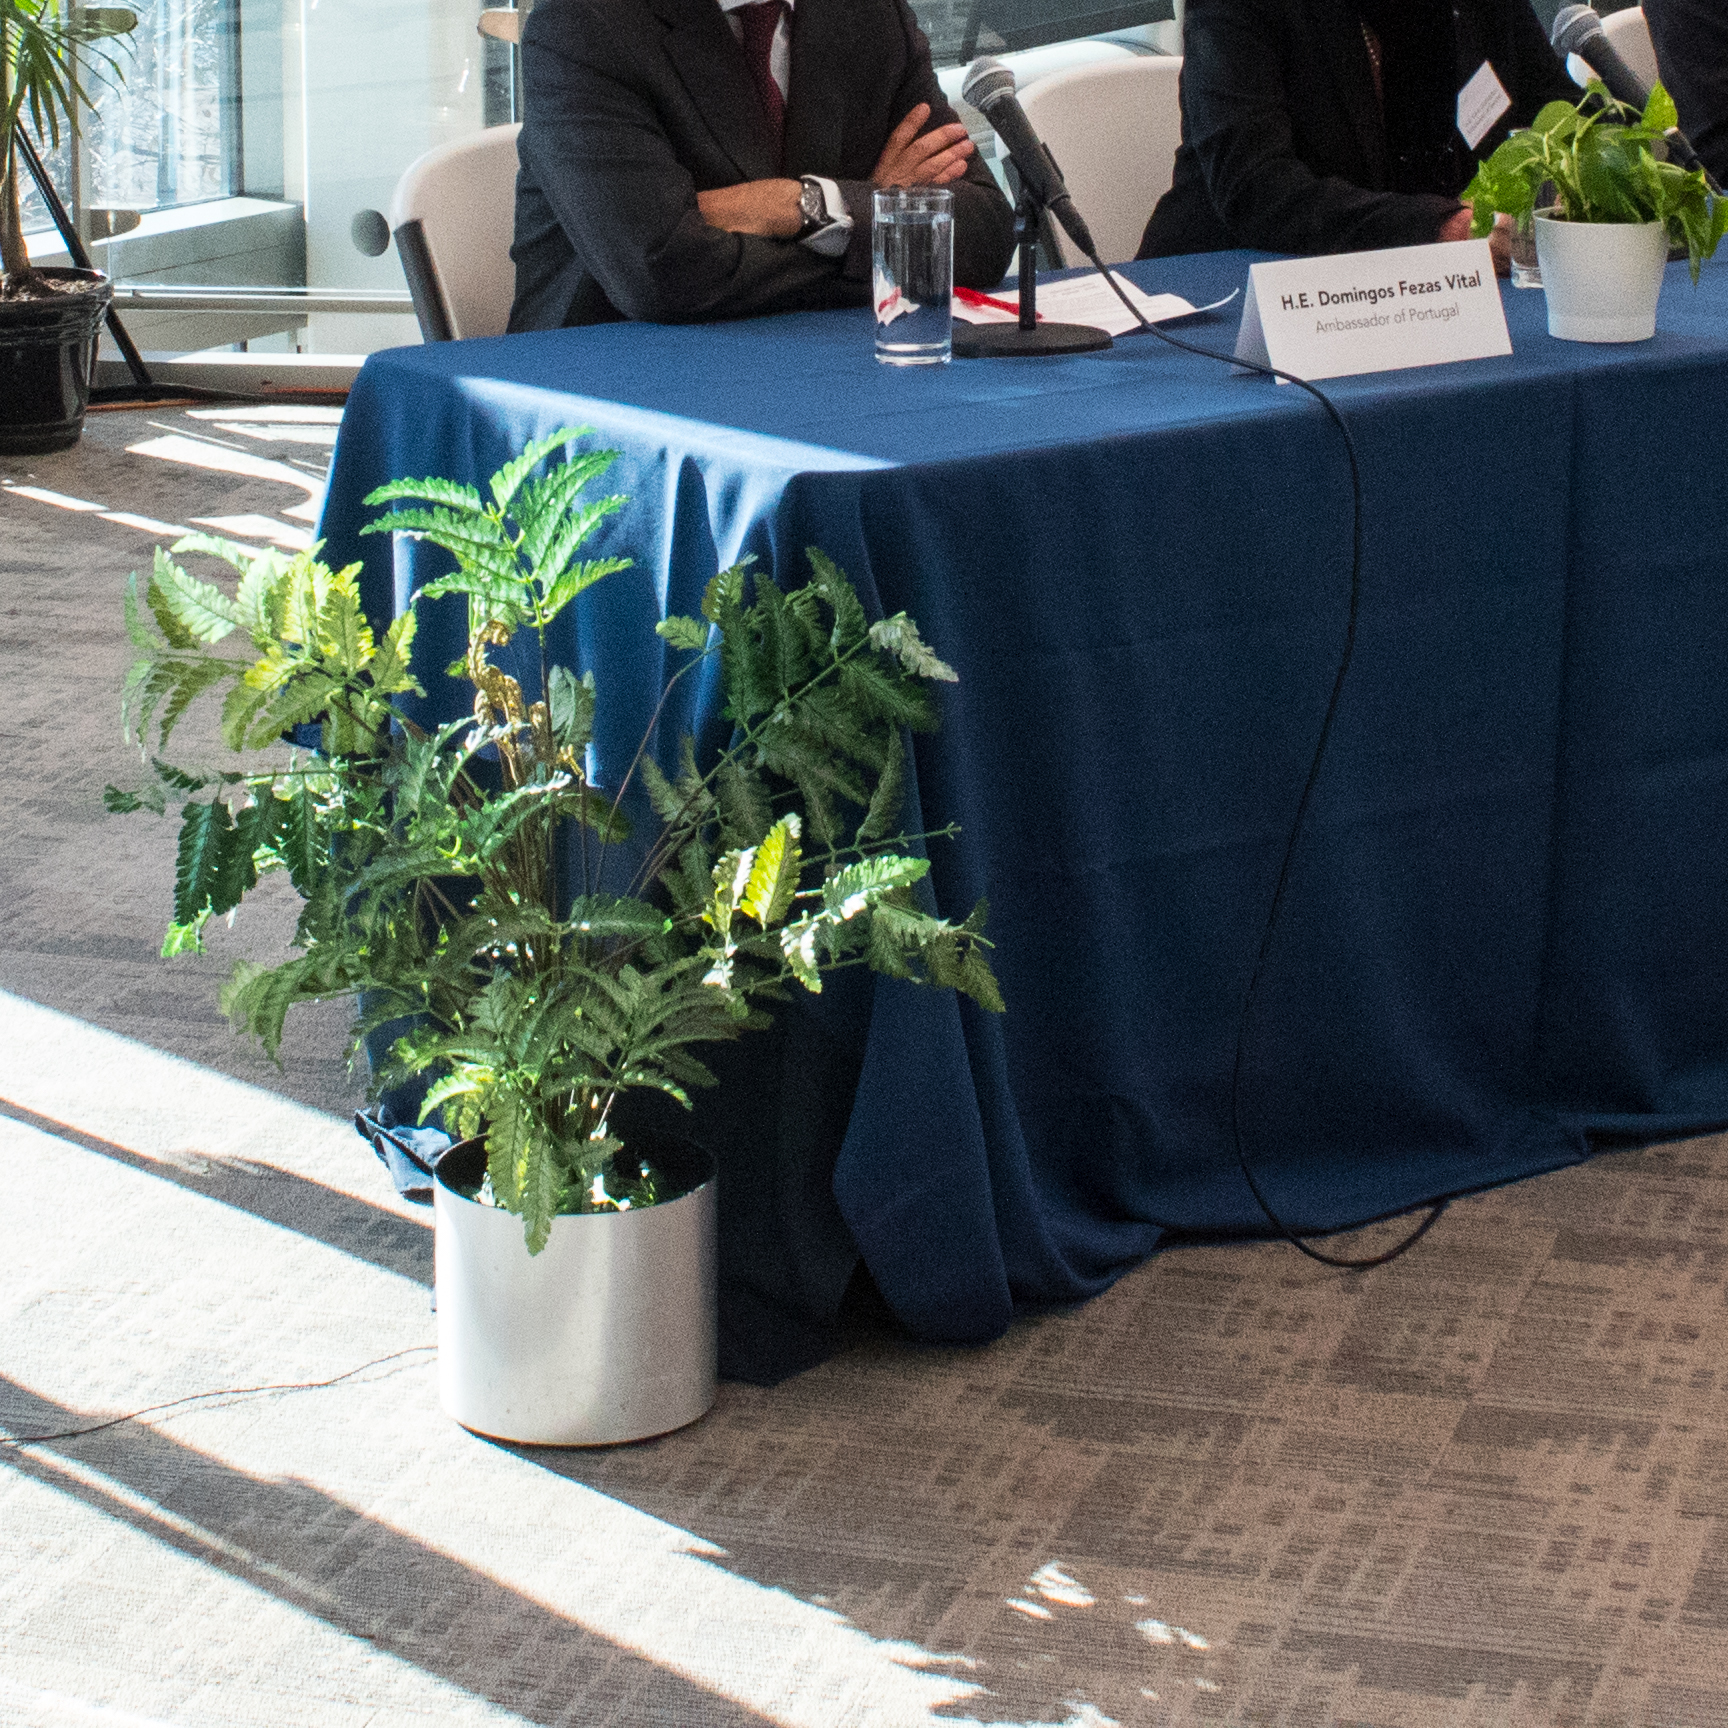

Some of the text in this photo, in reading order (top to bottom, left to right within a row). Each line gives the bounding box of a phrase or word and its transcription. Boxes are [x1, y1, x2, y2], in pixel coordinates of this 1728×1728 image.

[1281, 270, 1482, 311] H.E. Domingos Fezas Vital
[1315, 303, 1460, 334] Ambassador of Portugal
